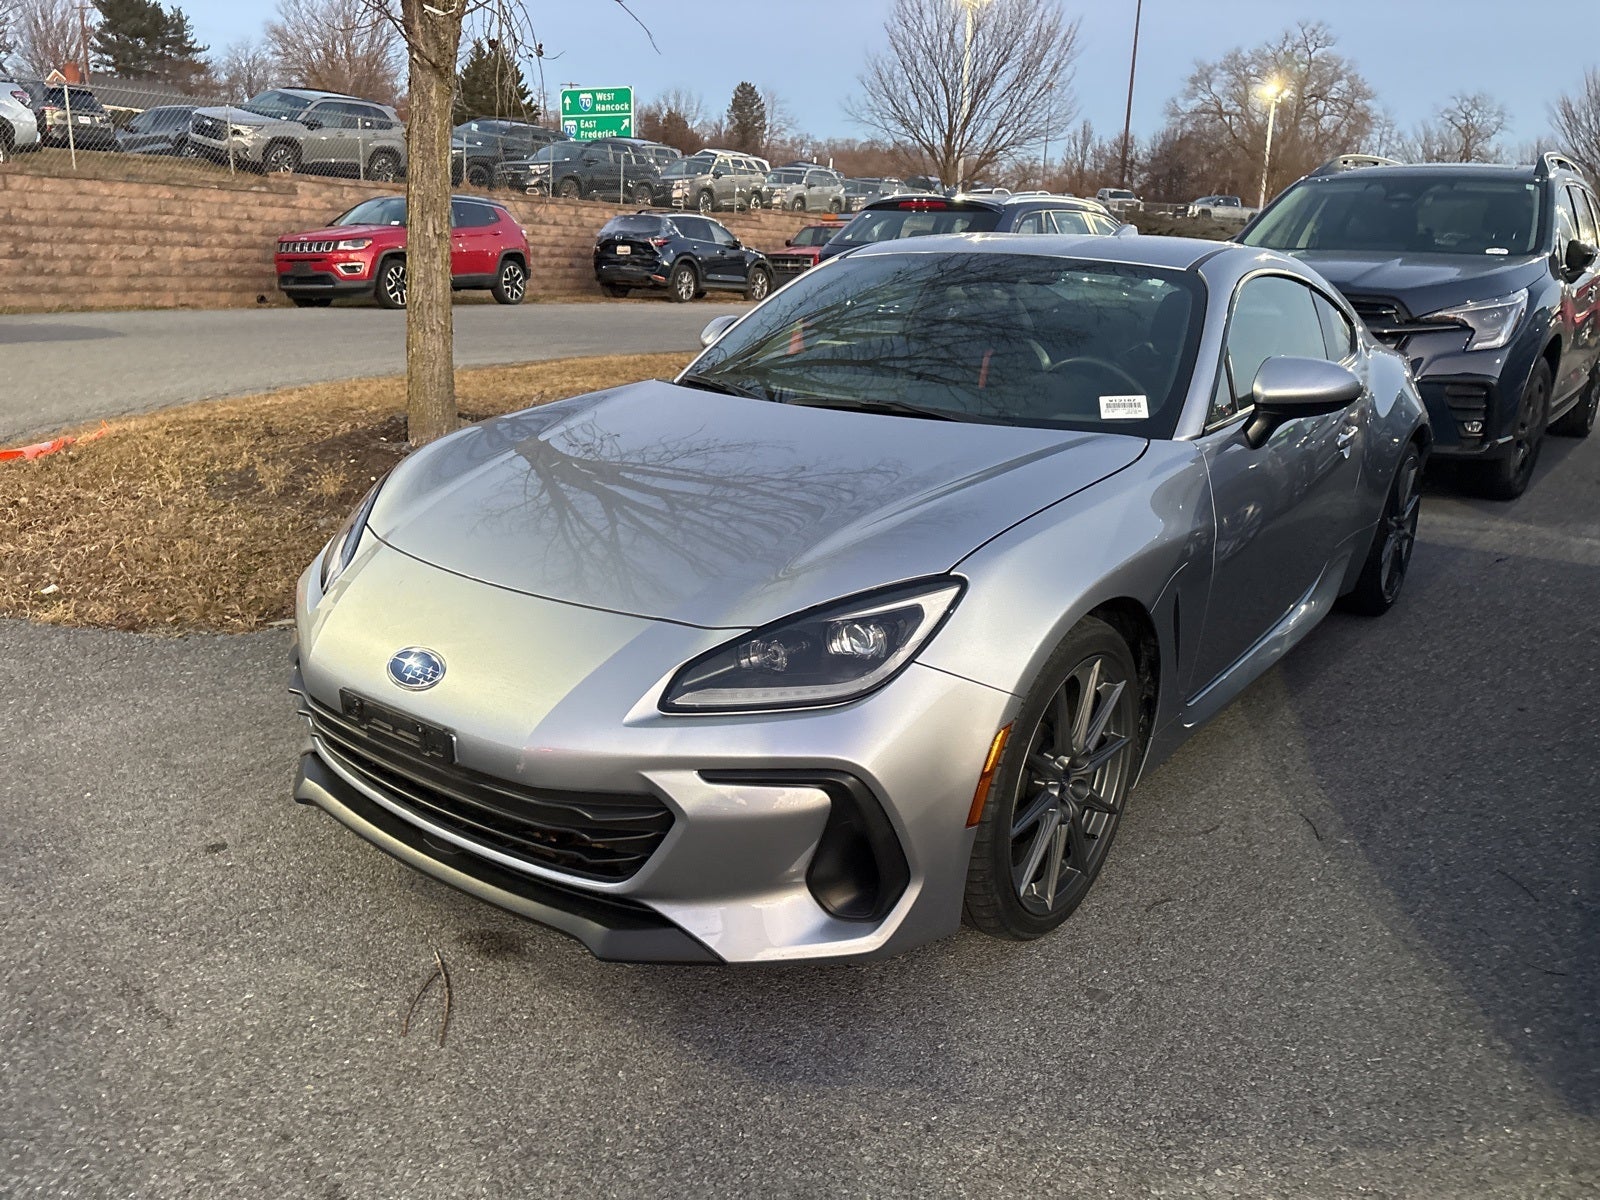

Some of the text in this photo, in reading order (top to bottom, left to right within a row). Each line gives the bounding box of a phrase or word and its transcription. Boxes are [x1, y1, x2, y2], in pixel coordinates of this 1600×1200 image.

[581, 99, 590, 107] 70
[596, 102, 629, 111] Hancock
[580, 120, 596, 128] EAST
[566, 126, 575, 134] 70
[580, 130, 618, 138] Frederick
